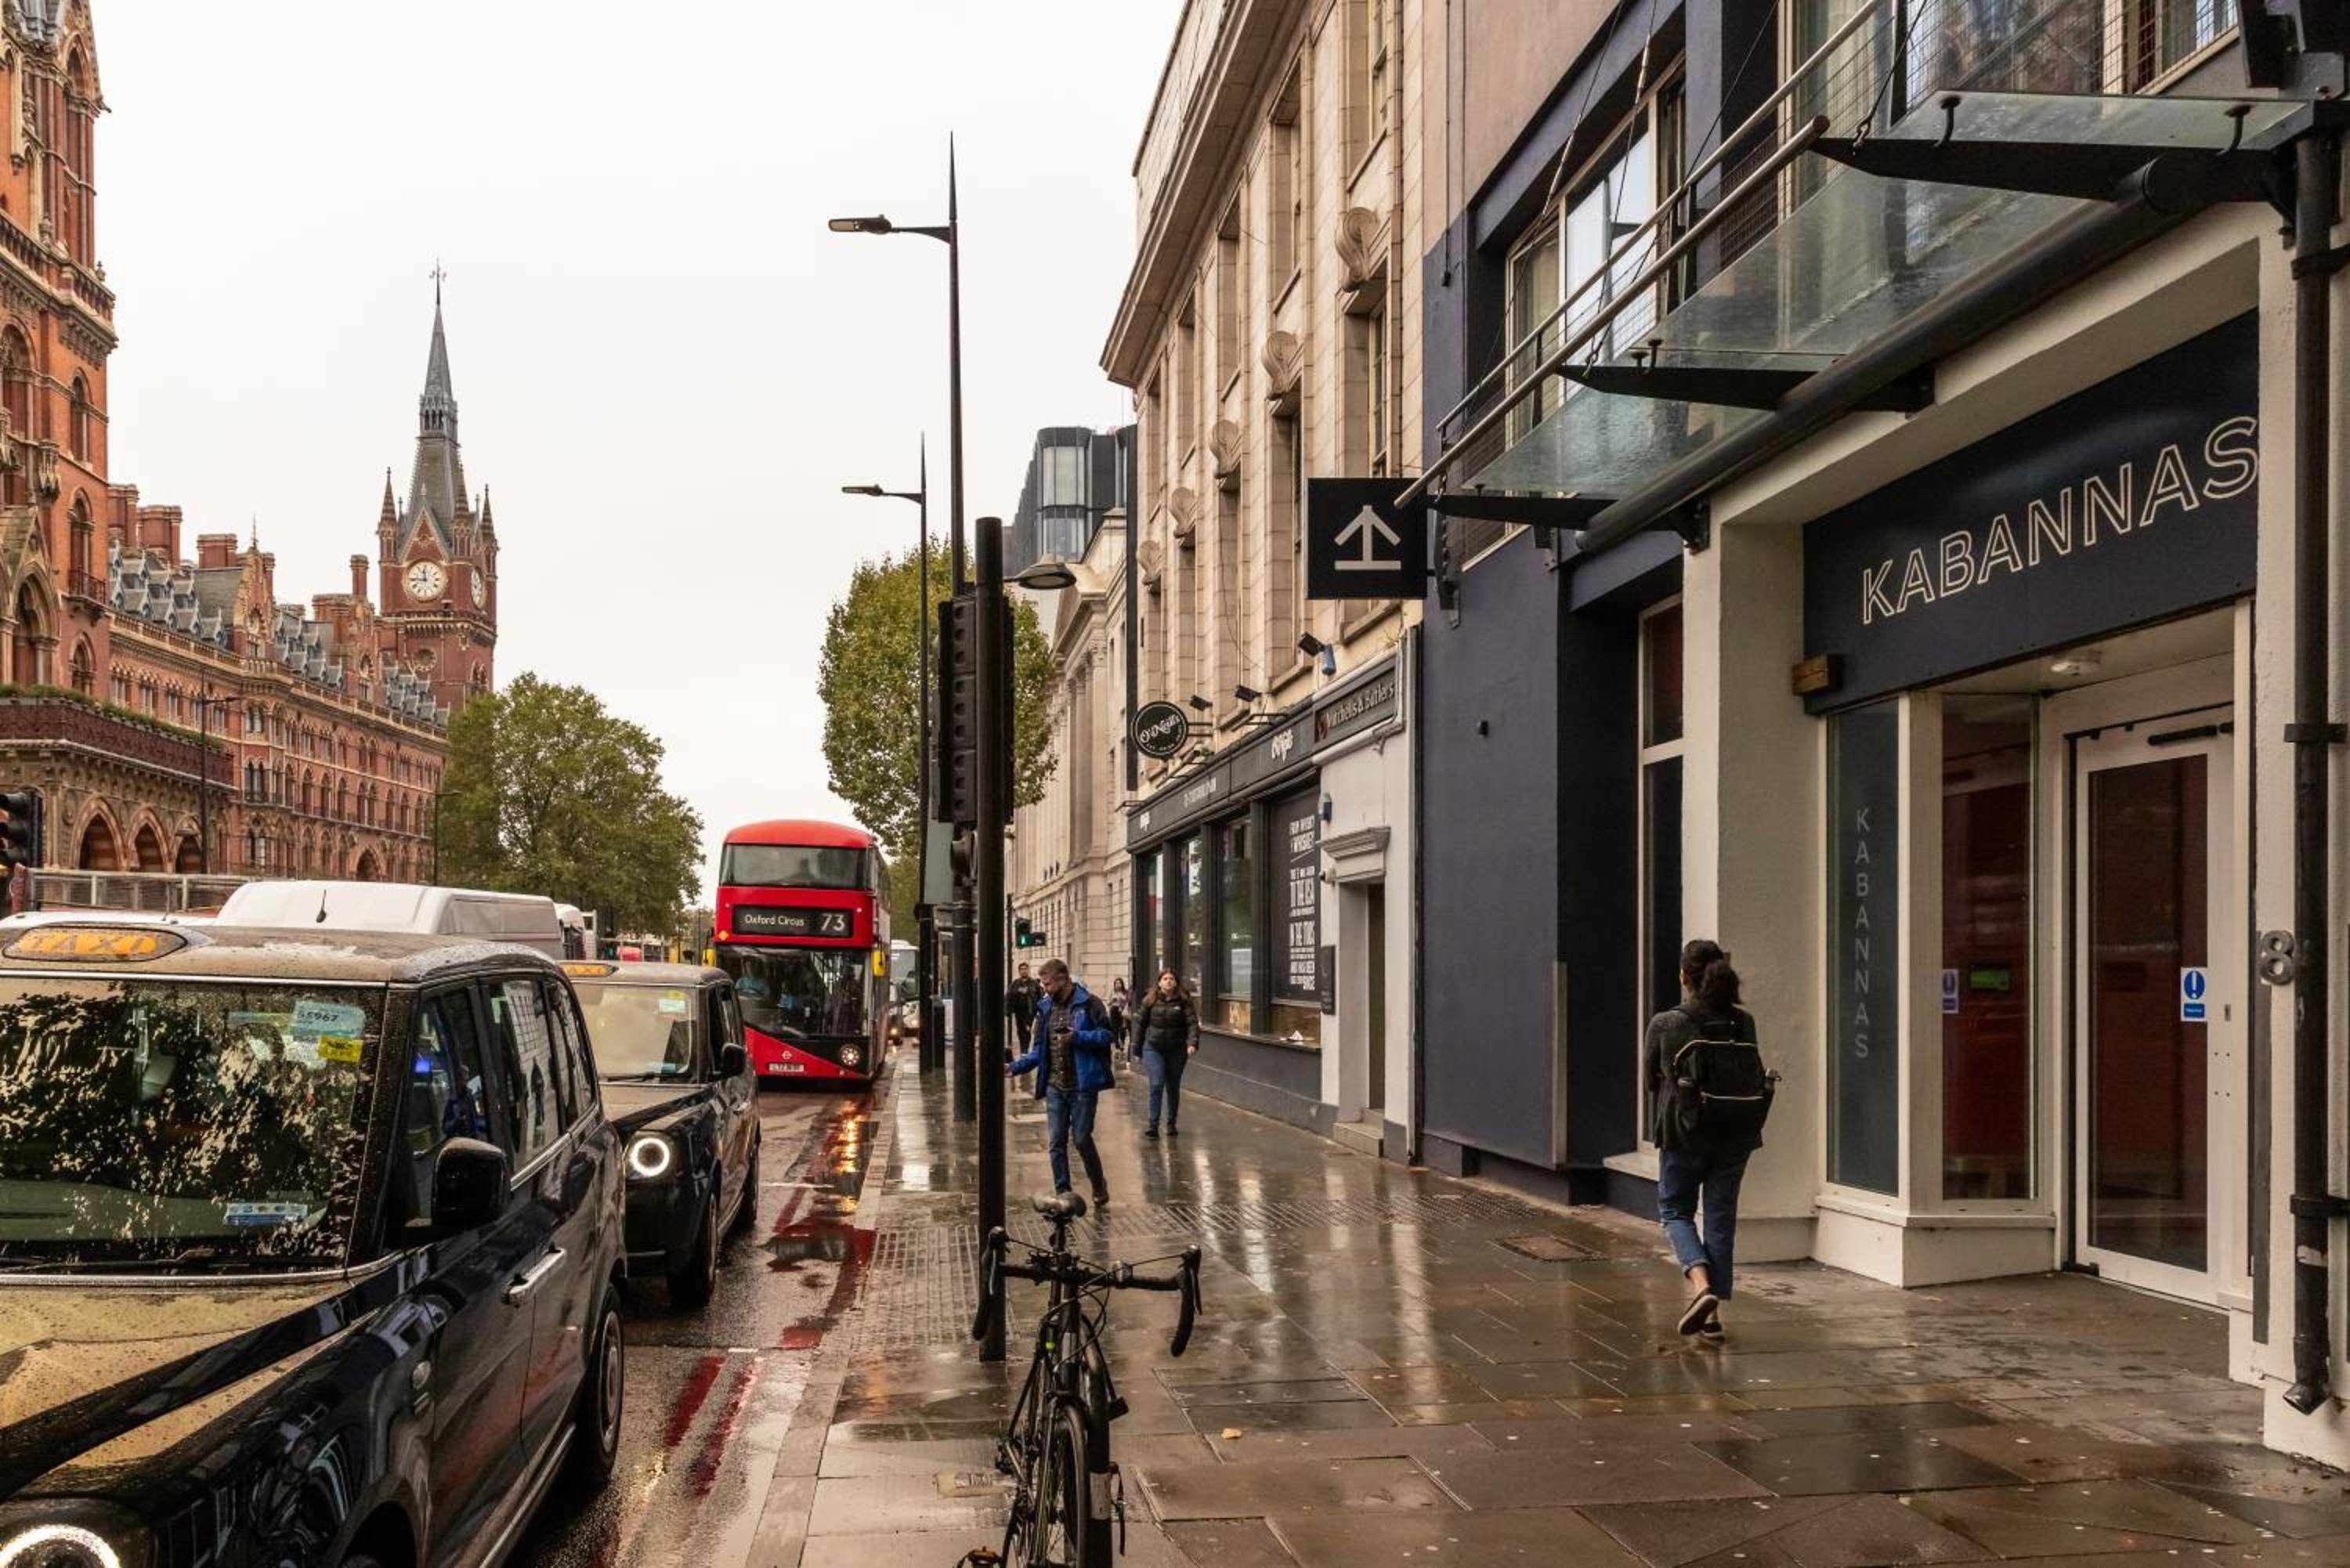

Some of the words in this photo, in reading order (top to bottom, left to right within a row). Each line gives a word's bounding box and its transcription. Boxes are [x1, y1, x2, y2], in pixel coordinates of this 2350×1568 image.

[1861, 416, 2259, 625] KABANNAS
[1366, 682, 1394, 710] Butlers
[25, 932, 152, 955] TAXI
[745, 915, 776, 926] Oxford
[778, 916, 804, 927] Circus
[821, 913, 846, 931] 73
[1854, 807, 1871, 1059] KABANNAS
[2260, 929, 2294, 987] 8
